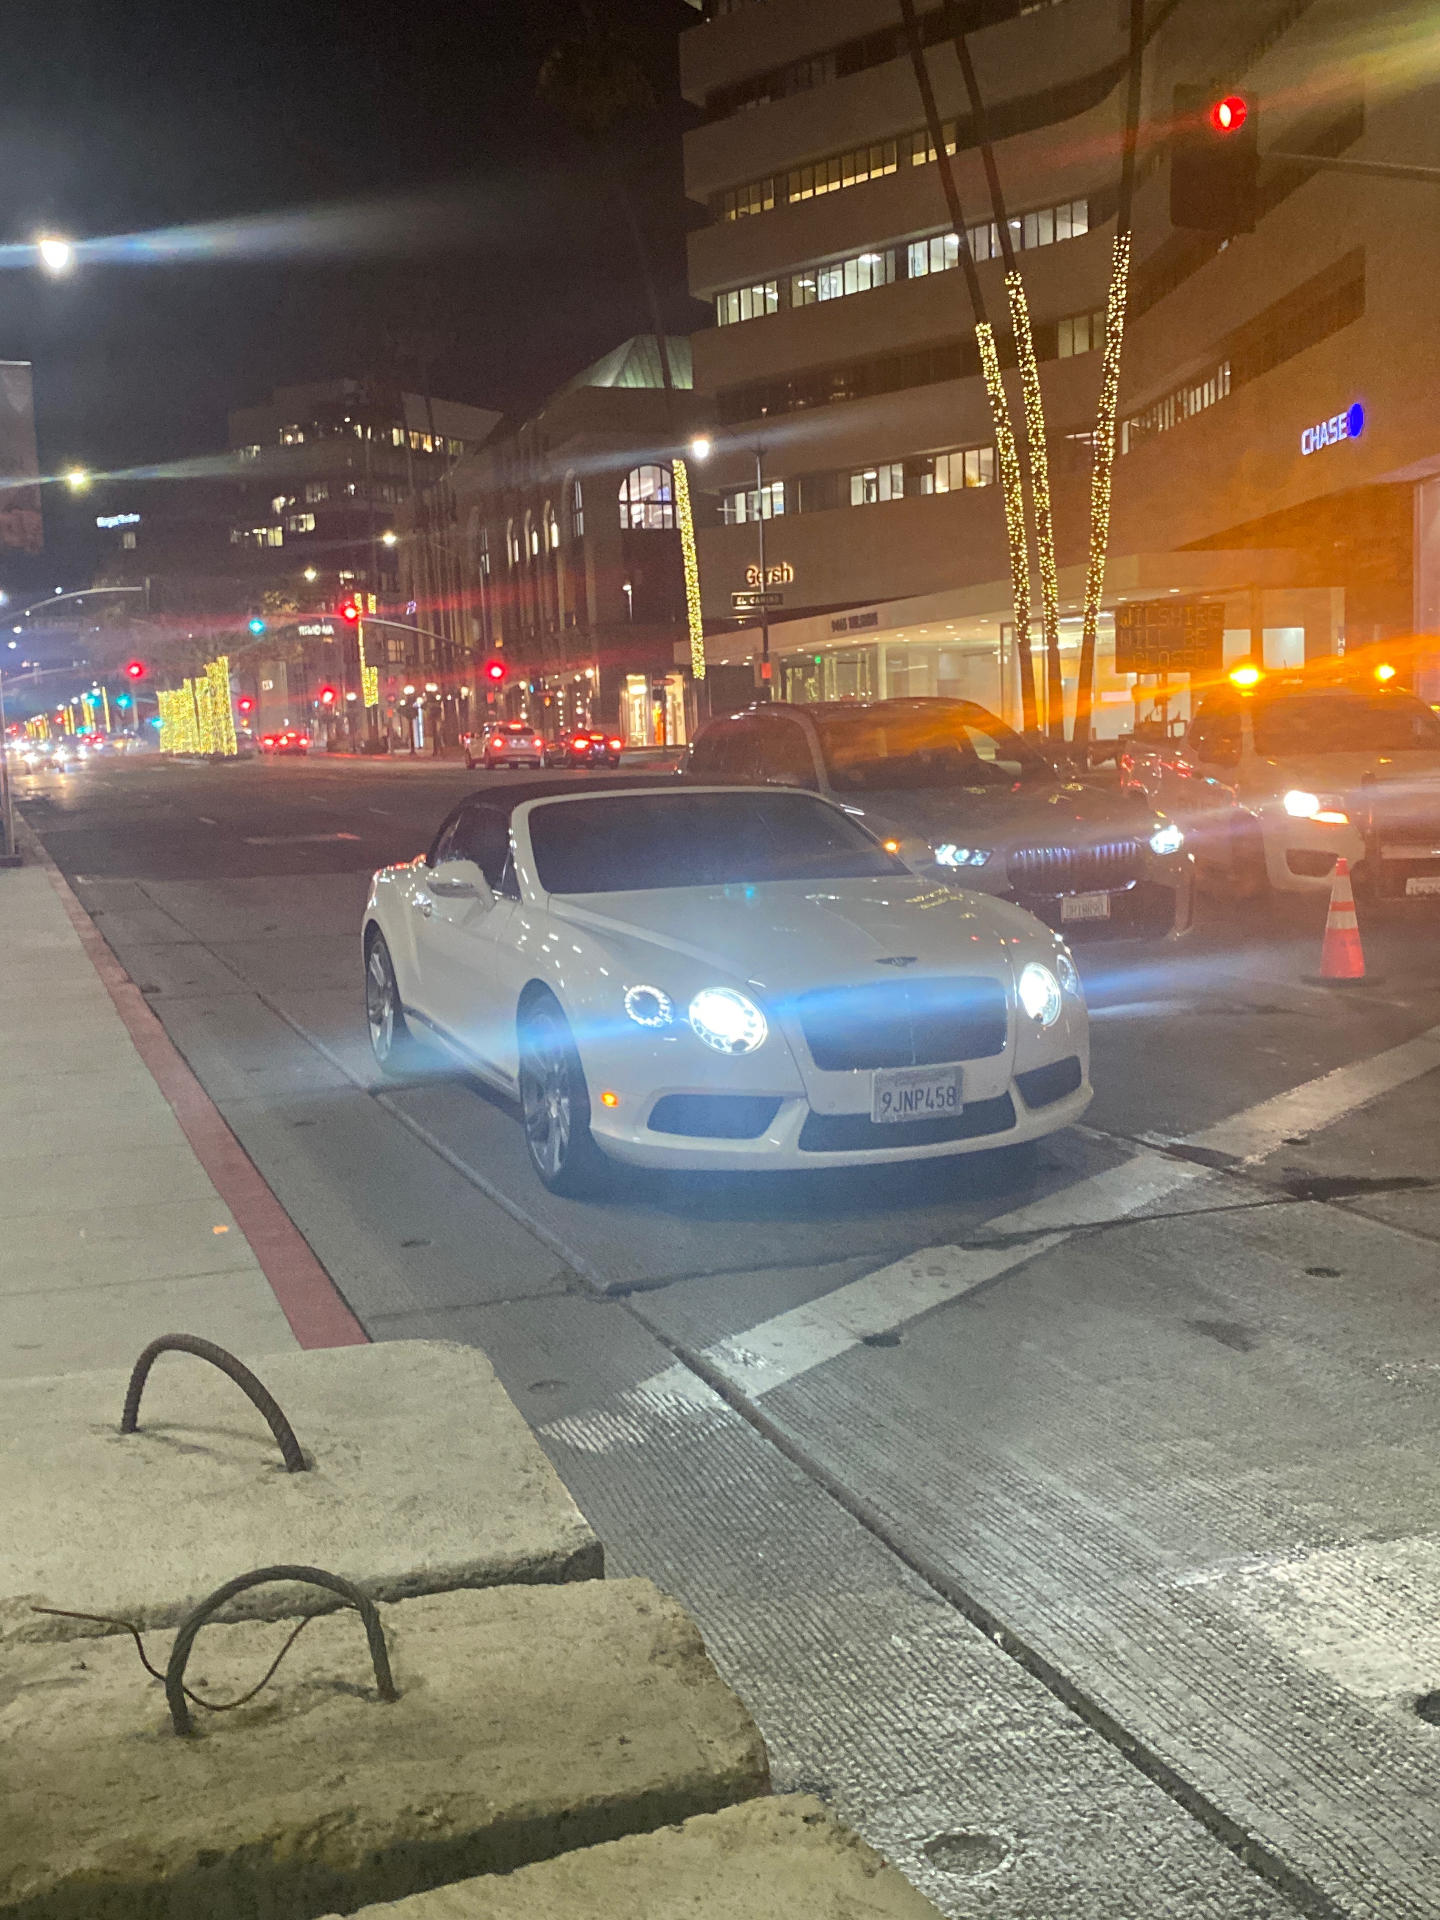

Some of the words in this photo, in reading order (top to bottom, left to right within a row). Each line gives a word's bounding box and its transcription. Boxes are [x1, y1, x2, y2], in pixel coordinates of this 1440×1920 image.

[1302, 412, 1347, 455] CHASE
[745, 561, 793, 587] Gersh
[737, 596, 747, 605] EL
[1183, 627, 1207, 647] BE
[881, 1085, 958, 1114] 9JNP458
